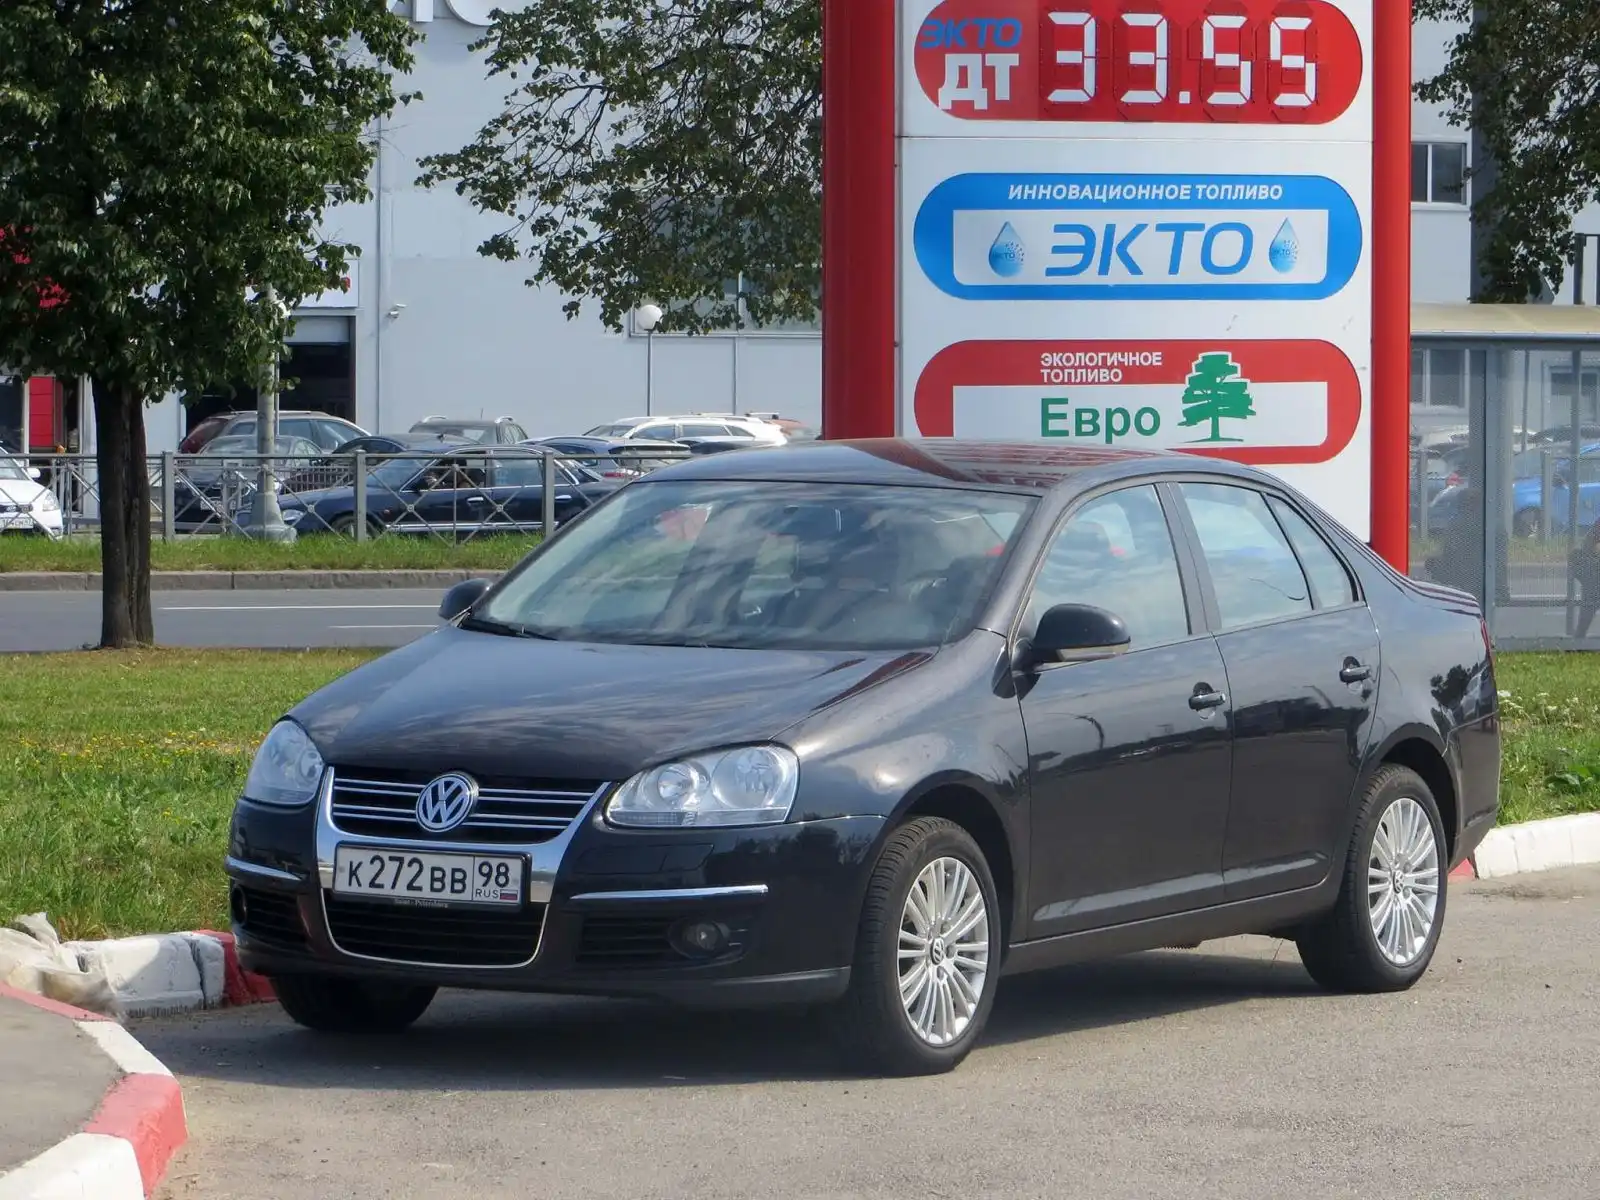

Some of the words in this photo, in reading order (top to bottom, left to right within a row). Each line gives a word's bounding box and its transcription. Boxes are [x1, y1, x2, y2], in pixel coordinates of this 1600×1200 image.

[920, 17, 1022, 49] ЭКТО
[1046, 11, 1317, 107] 33.55
[938, 53, 1020, 110] ДТ
[1008, 183, 1191, 203] ИННОВАЦИОННОЕ
[1196, 185, 1283, 200] ТОПЛИВО
[1045, 222, 1254, 277] ЭКТО
[1040, 352, 1163, 367] ЭКОЛОГИЧНОЕ
[1040, 368, 1123, 383] ТОПЛИВО
[1041, 398, 1161, 444] Евро
[478, 861, 510, 889] 98
[475, 888, 499, 899] RUS
